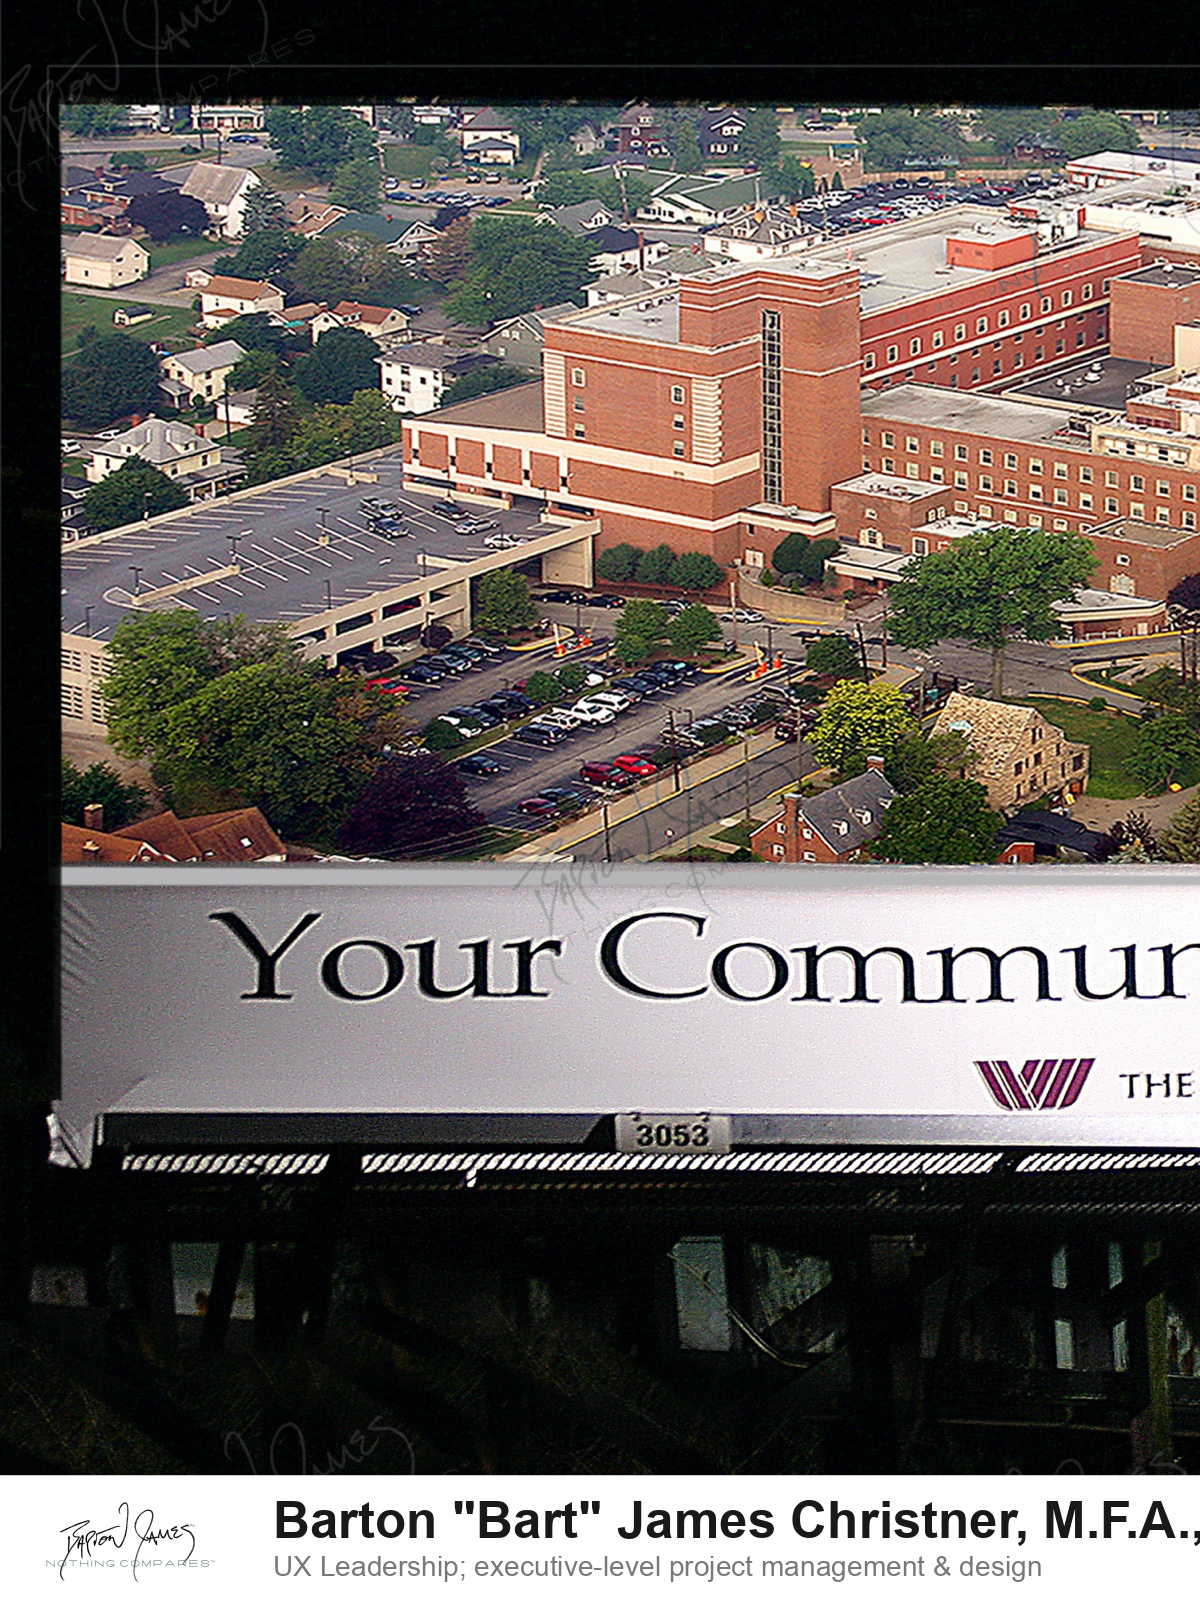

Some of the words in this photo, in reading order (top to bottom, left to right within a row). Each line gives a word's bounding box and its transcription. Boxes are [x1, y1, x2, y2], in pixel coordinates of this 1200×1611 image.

[209, 911, 561, 1001] Your
[1120, 1073, 1193, 1098] THE
[636, 1124, 709, 1147] 3053
